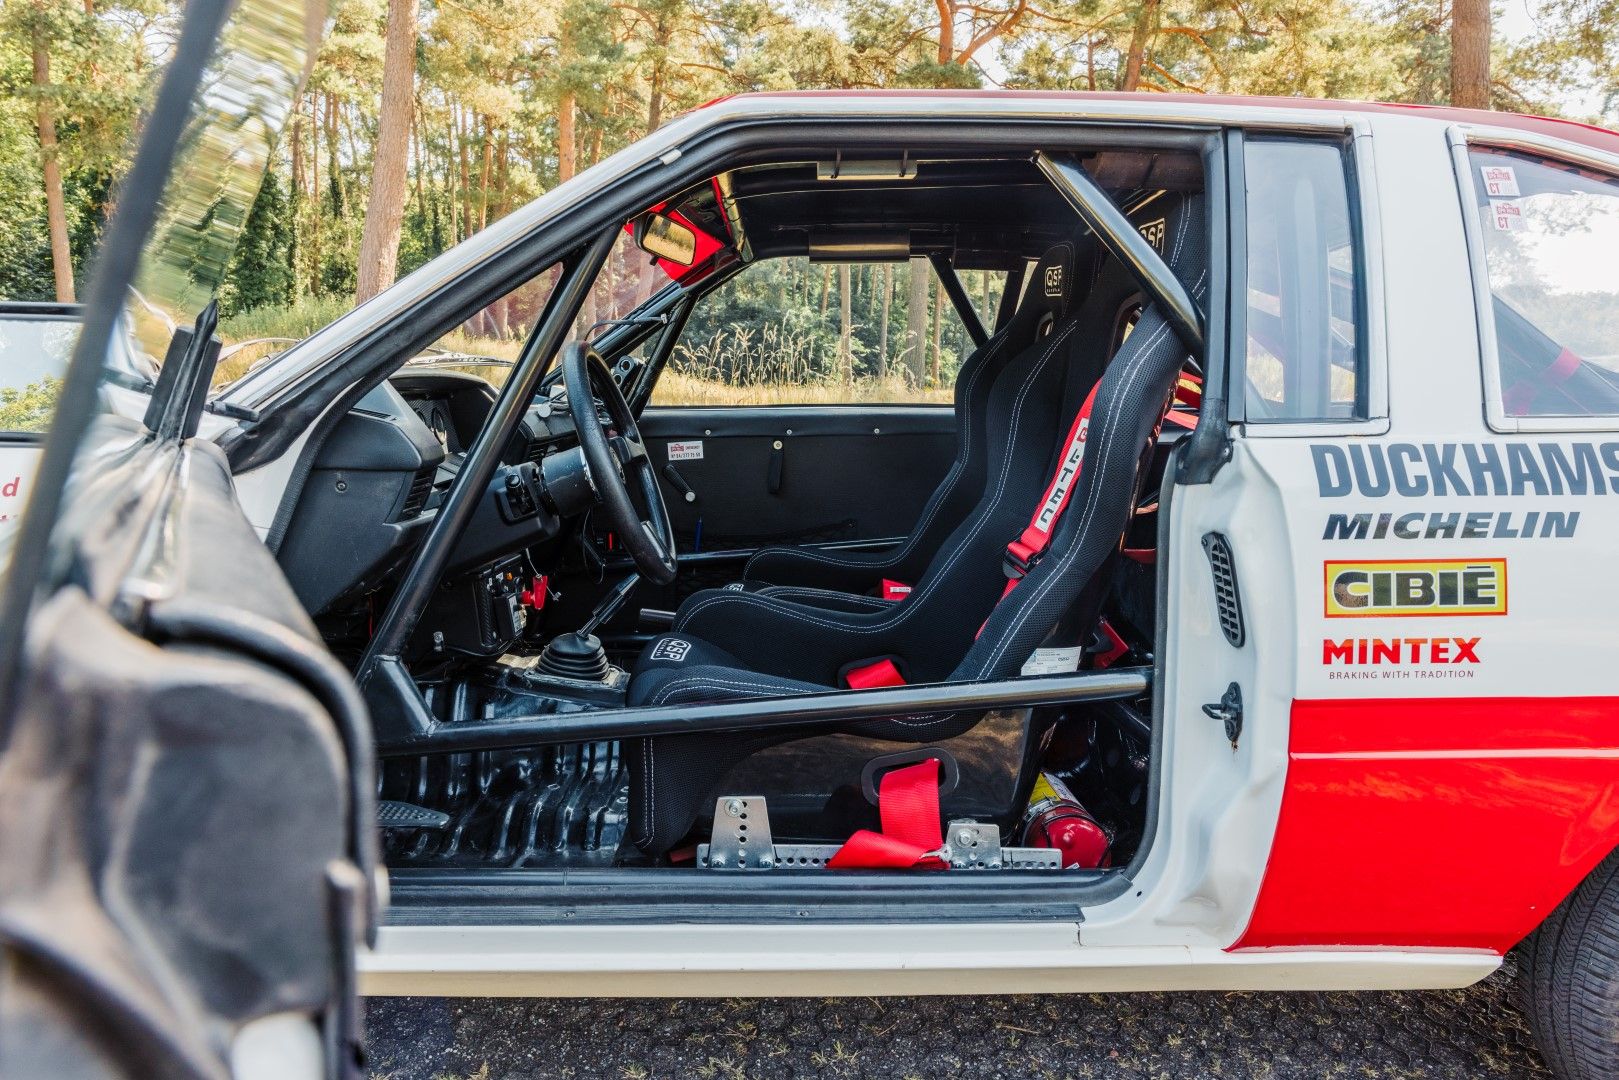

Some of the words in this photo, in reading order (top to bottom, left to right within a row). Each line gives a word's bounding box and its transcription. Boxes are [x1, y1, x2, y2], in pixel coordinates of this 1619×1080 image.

[1322, 511, 1581, 540] MICHELIN
[1323, 637, 1482, 665] MINTEX
[1329, 671, 1378, 680] BRAKING
[1382, 670, 1410, 679] WITH
[1414, 670, 1474, 679] TRADITION
